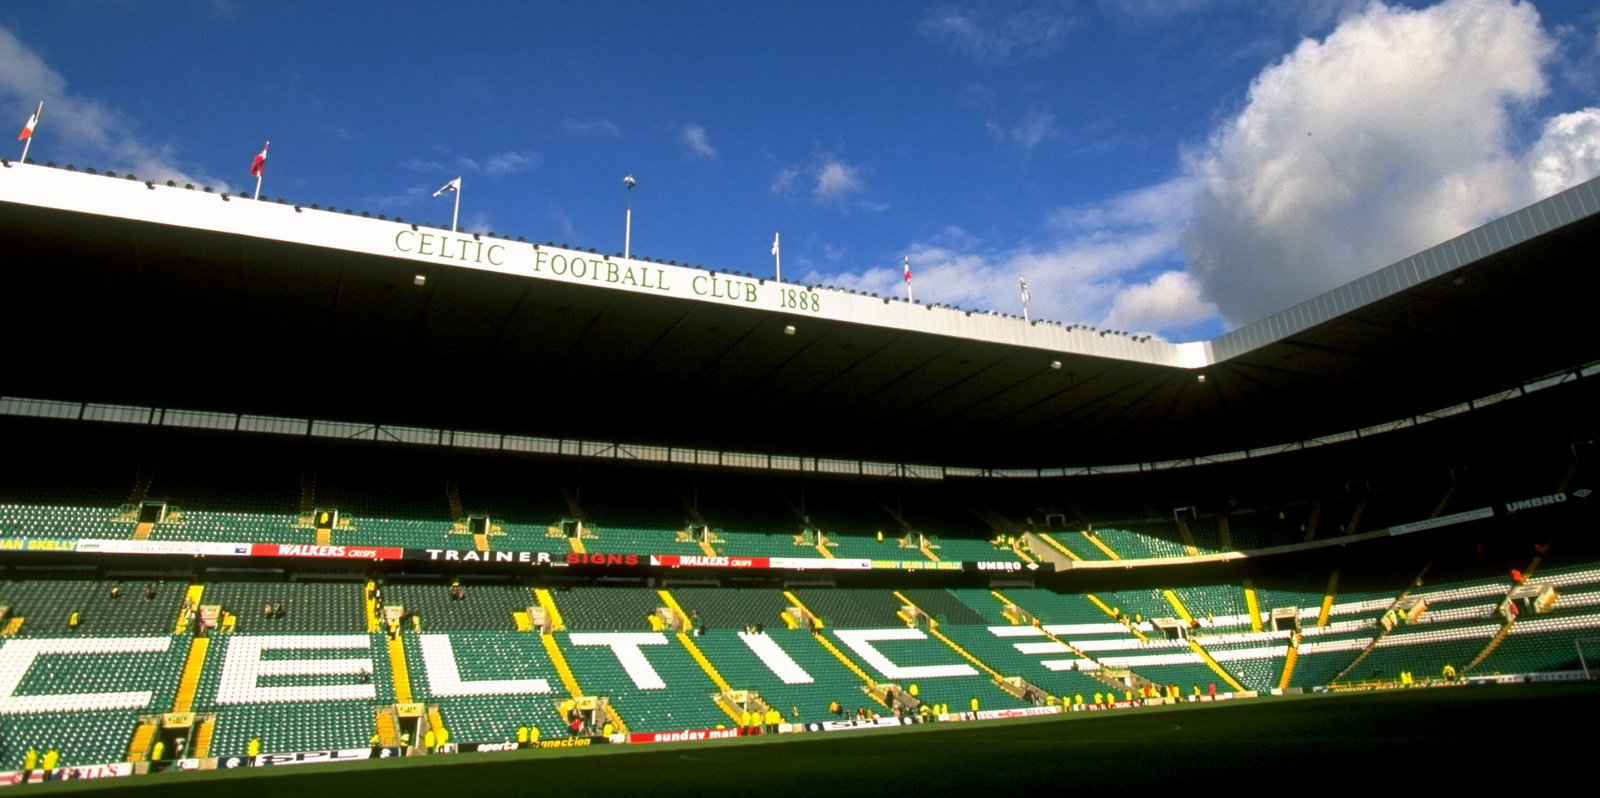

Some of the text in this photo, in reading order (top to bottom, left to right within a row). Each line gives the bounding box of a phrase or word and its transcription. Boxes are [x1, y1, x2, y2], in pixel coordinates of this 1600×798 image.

[394, 229, 820, 313] CELTIC FOOTBALL CLUB 1888
[1506, 492, 1567, 512] UMBRO
[26, 540, 78, 552] SKELLY
[278, 544, 377, 558] WALKERS CRISPS
[426, 549, 639, 565] TRAINER SIGNS
[679, 555, 752, 567] WALKERS CRISPS
[977, 561, 1022, 570] UMBRO
[0, 628, 979, 714] CELTIC
[831, 717, 892, 728] SPL
[654, 728, 738, 742] sunday mail
[532, 736, 592, 749] nnection
[262, 750, 359, 766] SPL
